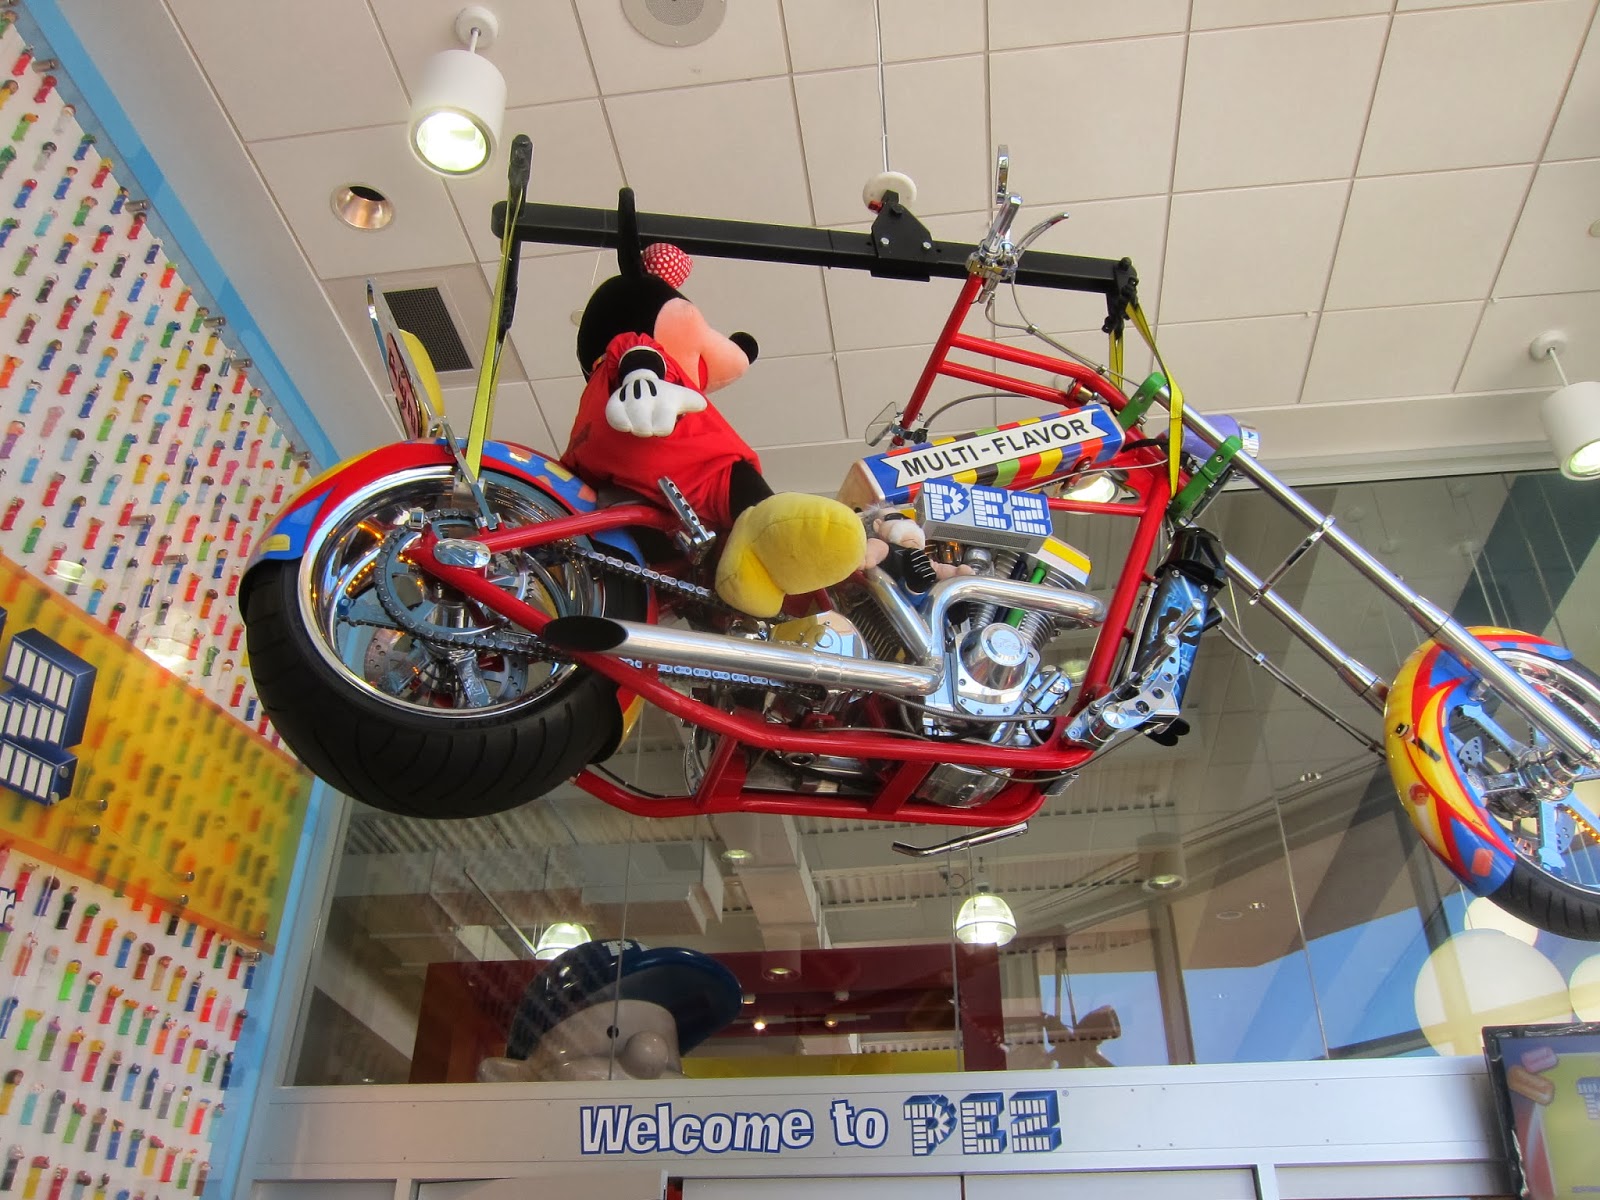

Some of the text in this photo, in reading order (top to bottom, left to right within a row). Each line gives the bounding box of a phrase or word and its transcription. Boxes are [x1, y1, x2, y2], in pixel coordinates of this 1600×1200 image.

[900, 418, 1090, 477] MULTI-FLAVOR
[923, 478, 1053, 536] PEZ
[579, 1089, 1063, 1156] Welcome to PEZ
